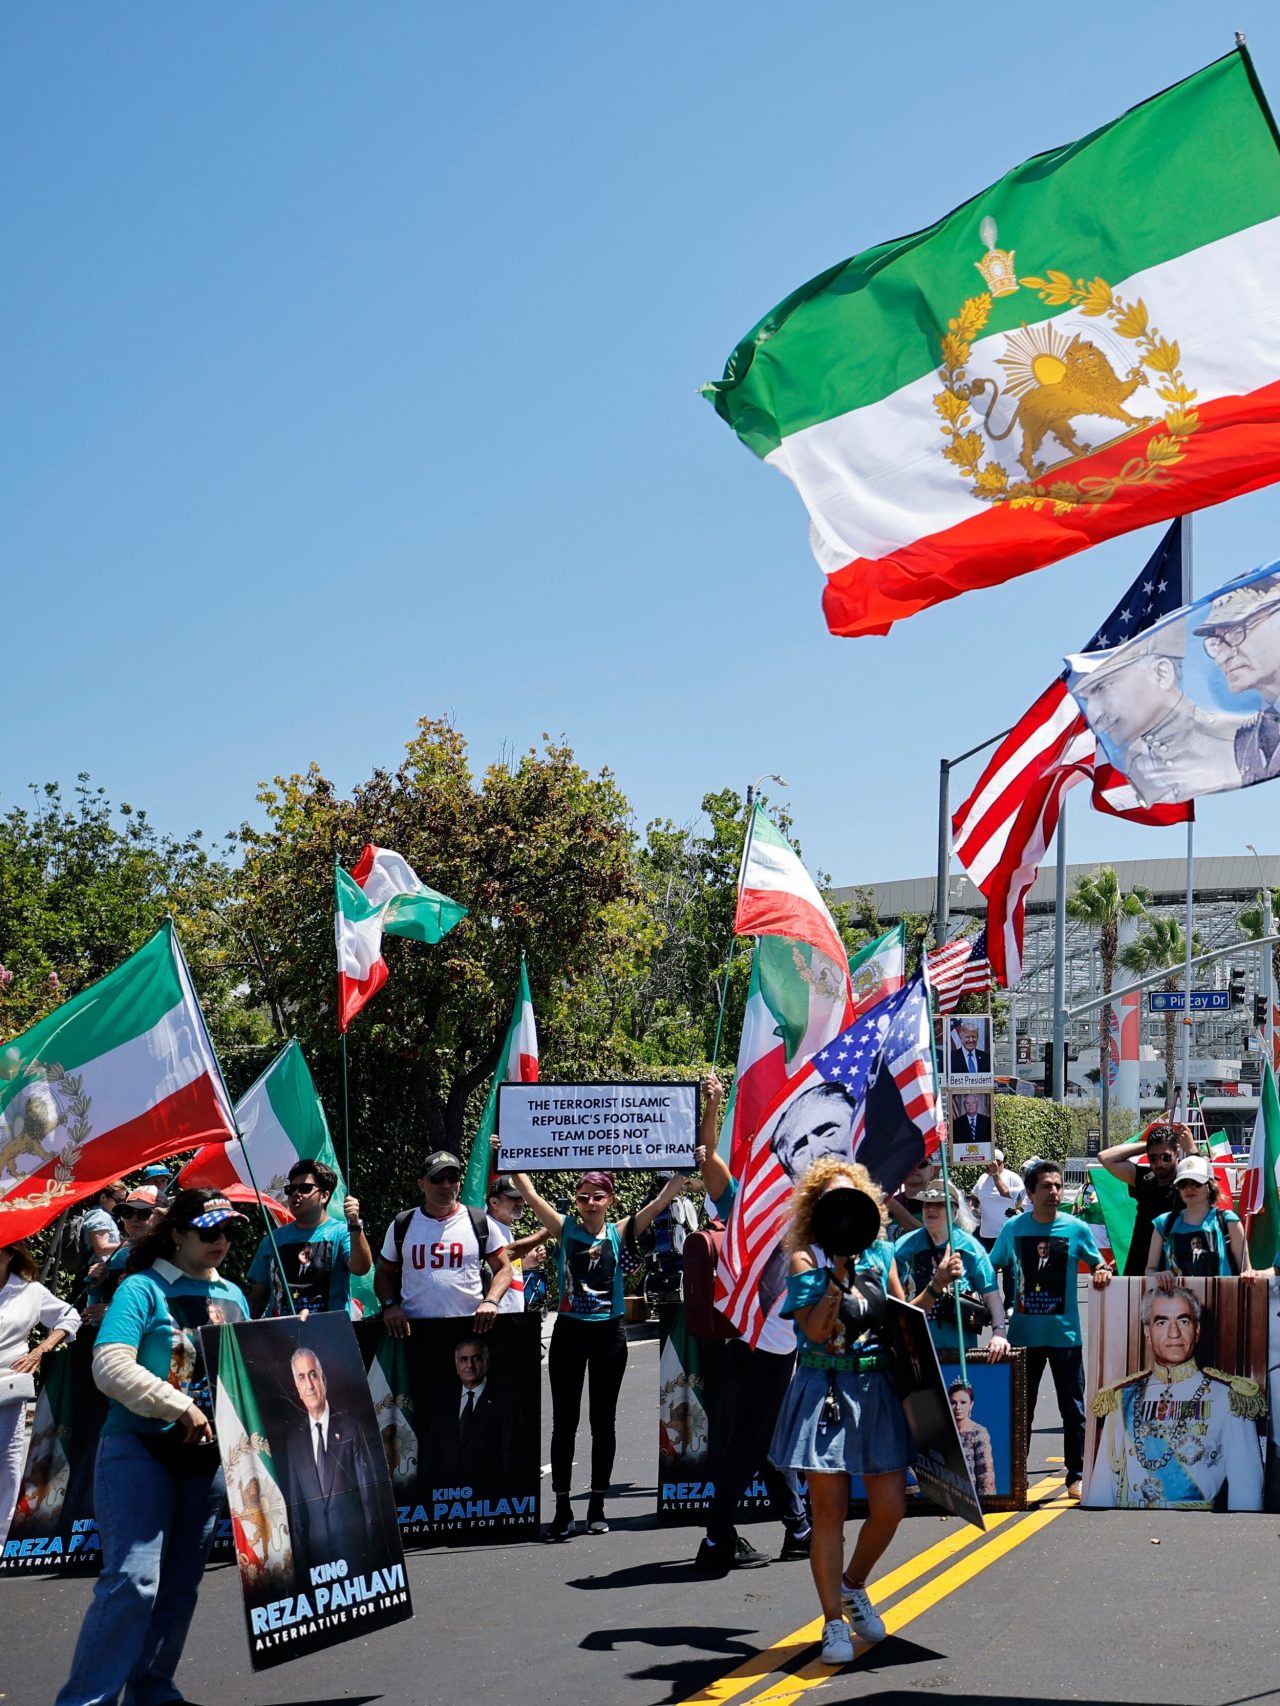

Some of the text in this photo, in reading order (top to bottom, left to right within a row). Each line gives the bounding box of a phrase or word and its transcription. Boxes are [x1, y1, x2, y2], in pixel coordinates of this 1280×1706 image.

[1170, 996, 1226, 1008] Pincay Dr
[950, 1076, 963, 1085] Best
[964, 1075, 992, 1085] President
[527, 1097, 671, 1111] THE TERRORIST ISLAMIC
[532, 1113, 666, 1126] REPUBLIC'S FOOTBALL
[551, 1128, 650, 1141] TEAM DOES NOT
[501, 1143, 695, 1159] REPRESENT THE PEOPLE OF IRAN
[411, 1242, 464, 1270] USA
[432, 1486, 473, 1501] KING
[662, 1481, 715, 1500] REZA
[396, 1496, 536, 1524] ZA PAHLAVI
[756, 1499, 771, 1507] FO
[403, 1516, 535, 1533] RNATIVE FOR IRAN
[3, 1536, 63, 1558] REZA
[0, 1553, 96, 1568] ALTERNATIVE
[309, 1559, 348, 1586] KING
[250, 1564, 405, 1635] REZA PAHLAVI
[255, 1592, 407, 1651] ALTERNATIVE FOR IRAN
